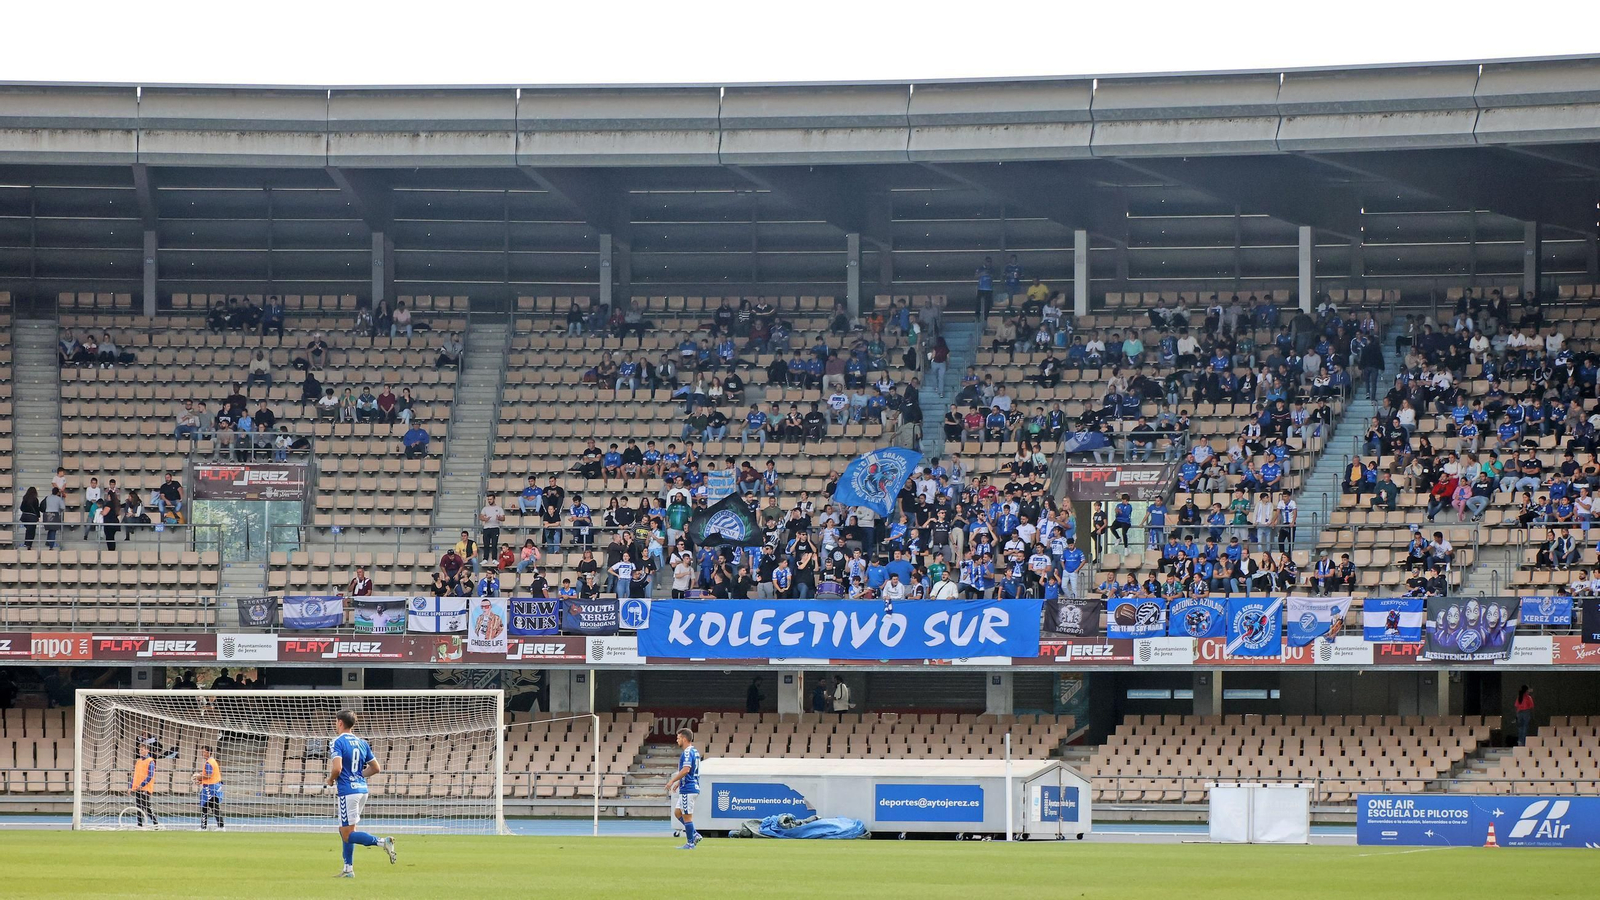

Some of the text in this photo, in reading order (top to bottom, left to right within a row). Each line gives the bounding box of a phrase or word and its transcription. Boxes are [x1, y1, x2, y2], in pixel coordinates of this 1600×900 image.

[199, 470, 240, 480] PLAY
[1072, 471, 1113, 482] PLAY
[512, 601, 557, 615] NEW
[580, 604, 615, 613] YOUTH
[1172, 598, 1198, 615] RATONES
[512, 615, 557, 630] ONES
[580, 613, 616, 621] XEREZ
[667, 607, 1010, 649] KOLECTIVO SUR
[80, 639, 88, 654] SIN
[100, 640, 145, 651] PLAY
[285, 641, 330, 652] PLAY
[471, 639, 491, 647] CHOOSE
[1040, 645, 1063, 656] AY
[1381, 644, 1424, 655] PLAY
[1425, 651, 1472, 661] RESISTENCIA
[351, 748, 360, 773] 8
[879, 798, 980, 809] deportes@aytojerez.es
[1368, 800, 1414, 809] ONE AIR
[1368, 810, 1469, 818] ESCUELA DE PILOTOS
